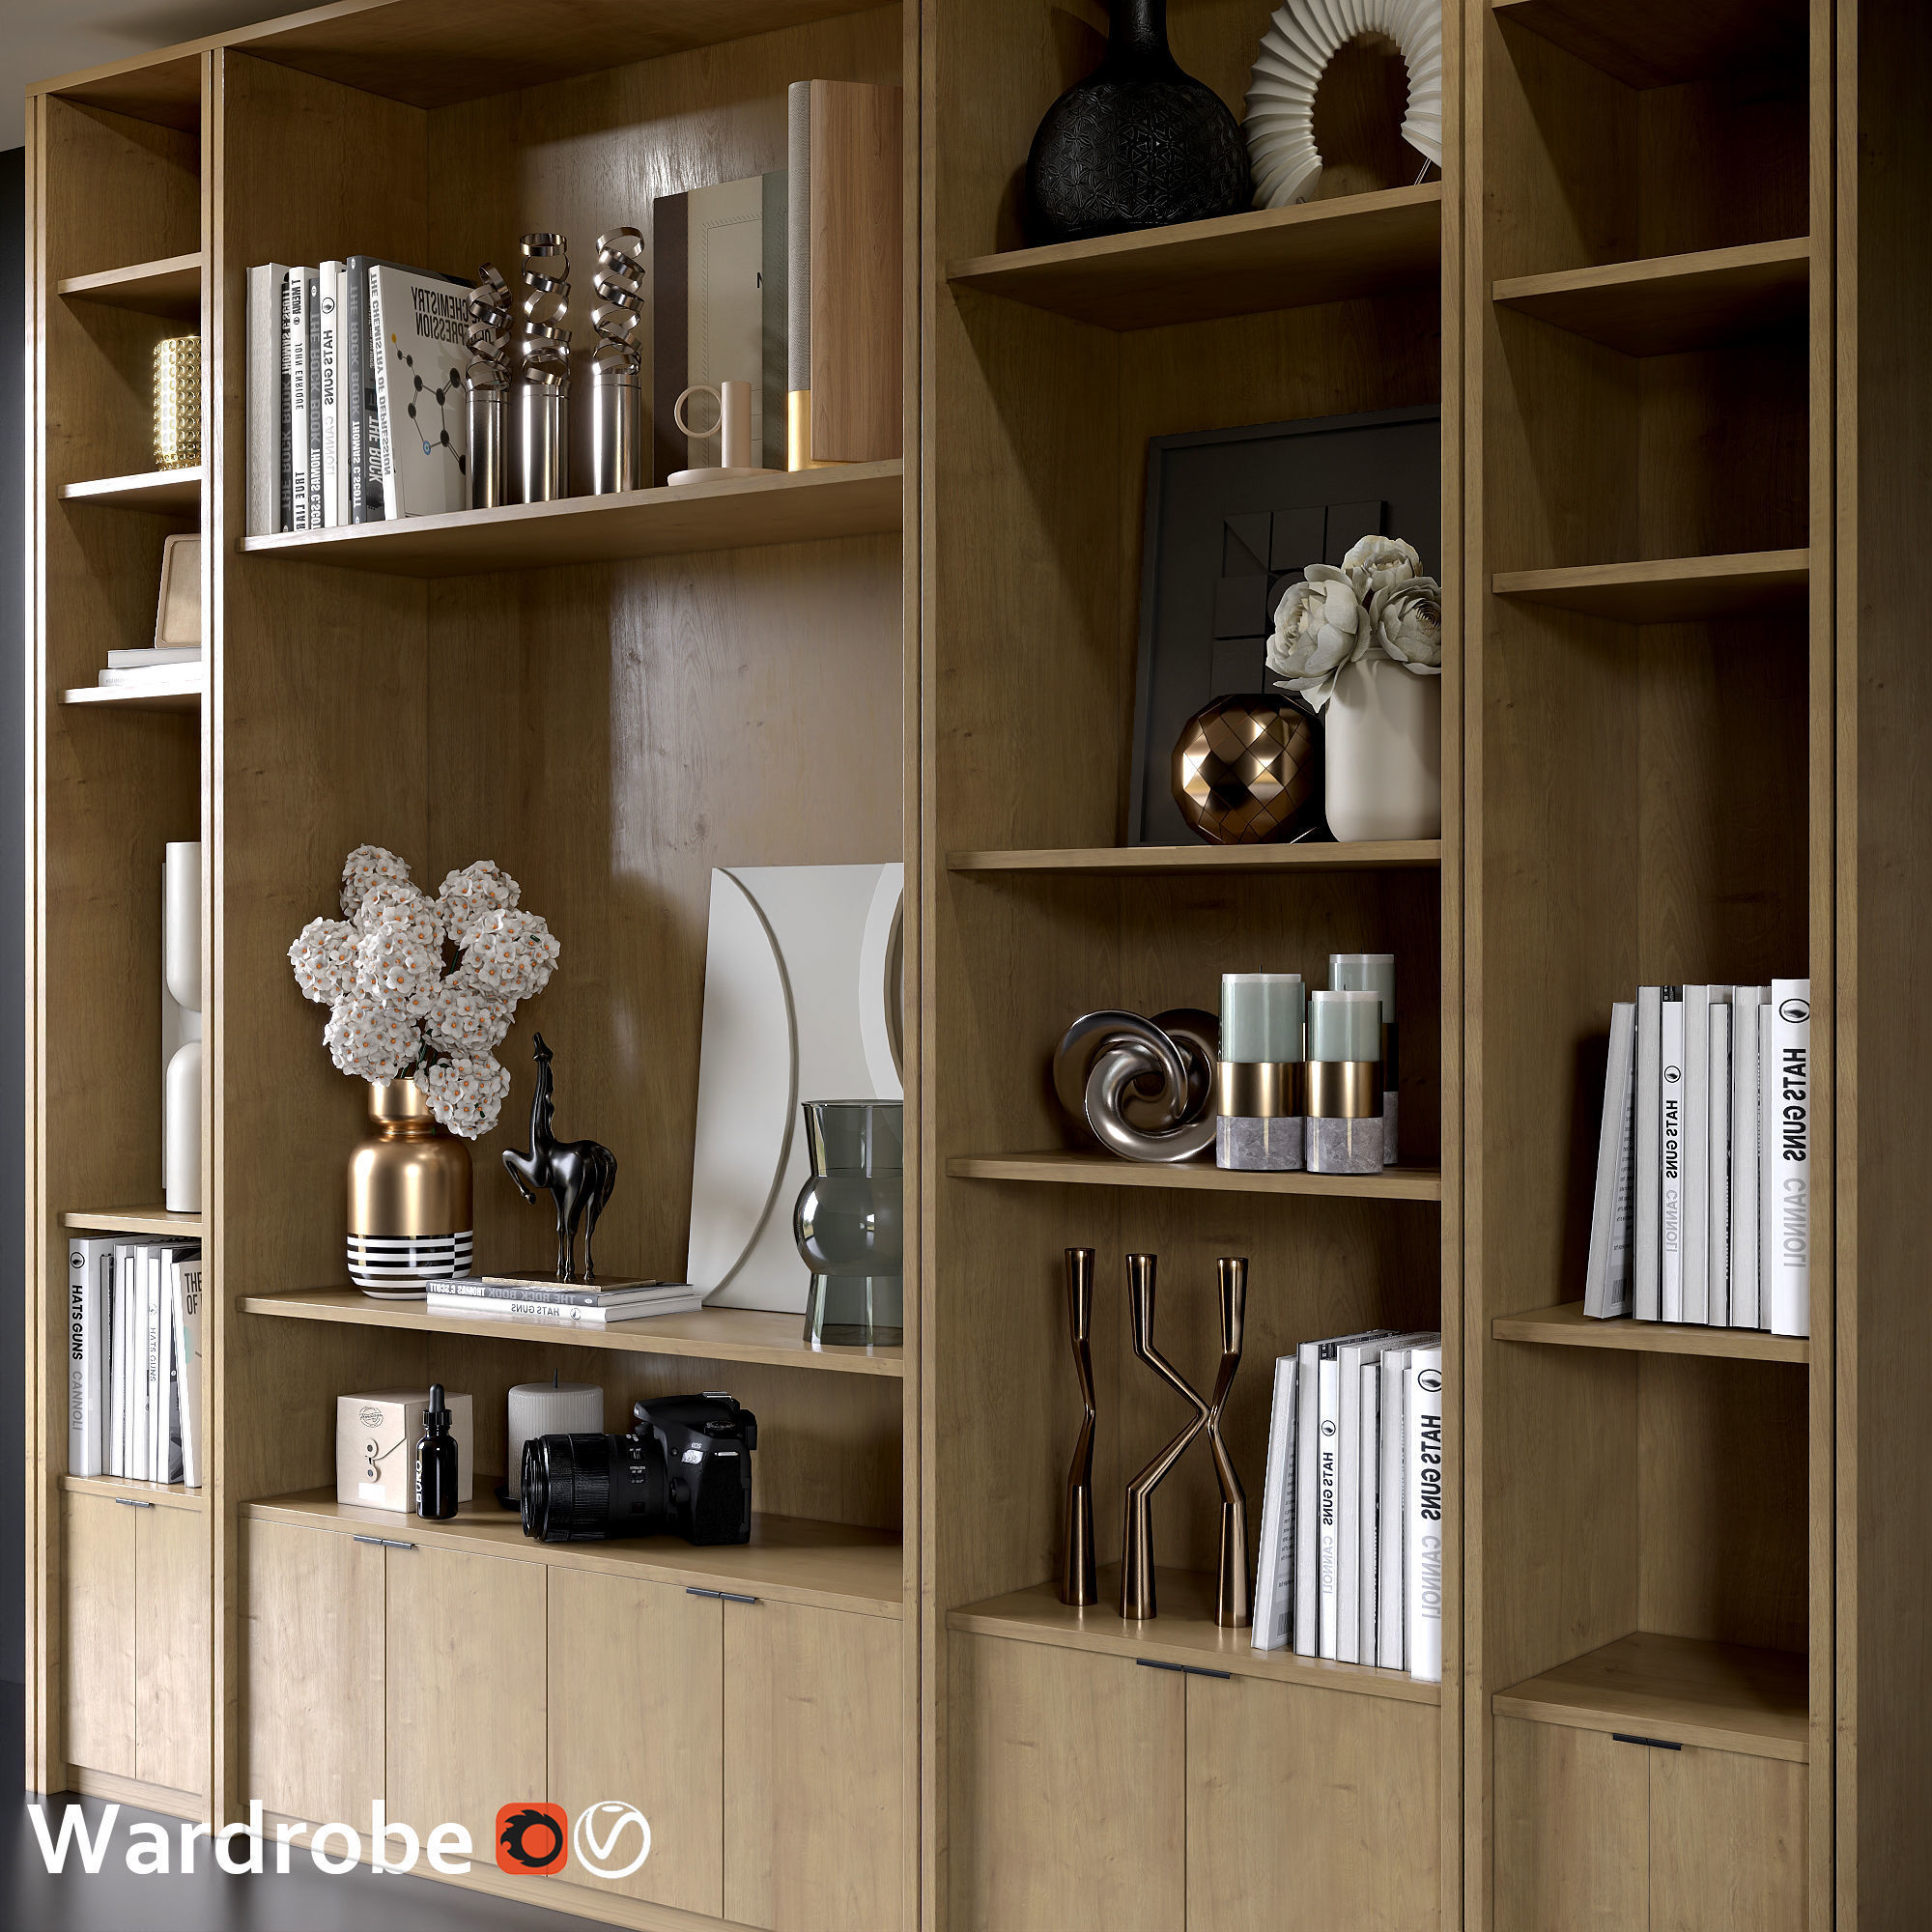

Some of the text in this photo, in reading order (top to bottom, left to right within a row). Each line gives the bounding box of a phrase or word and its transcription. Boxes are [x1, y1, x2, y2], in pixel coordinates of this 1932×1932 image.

[184, 1271, 202, 1293] THE
[186, 1294, 198, 1316] OF
[71, 1285, 83, 1431] HATS GUNS CANNOLI
